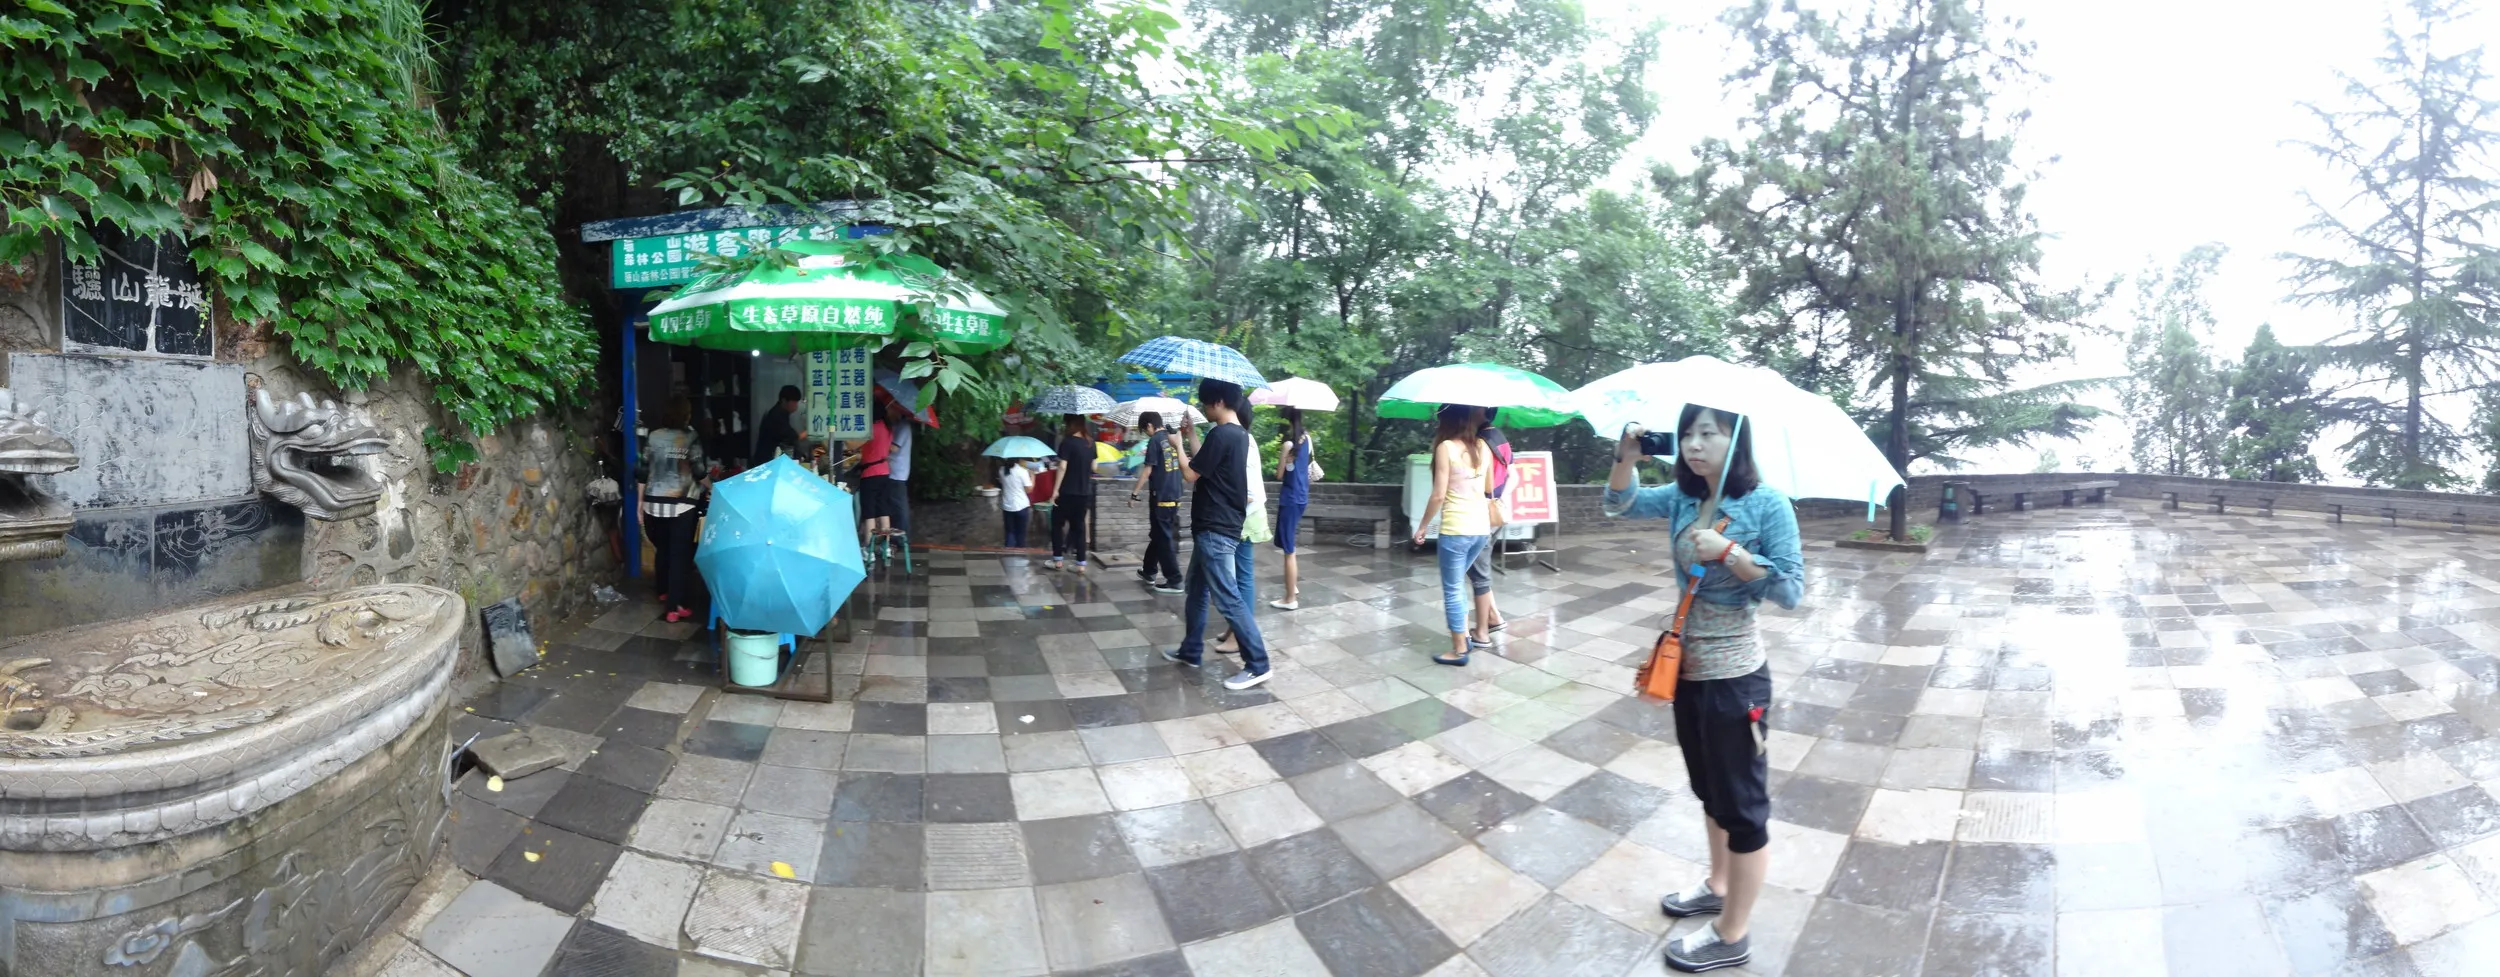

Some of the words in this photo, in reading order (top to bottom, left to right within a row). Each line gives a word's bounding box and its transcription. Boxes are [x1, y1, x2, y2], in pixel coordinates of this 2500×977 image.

[624, 249, 682, 266] 森林公园
[742, 304, 886, 327] 生态草原自然纯
[1513, 463, 1543, 503] 下山
